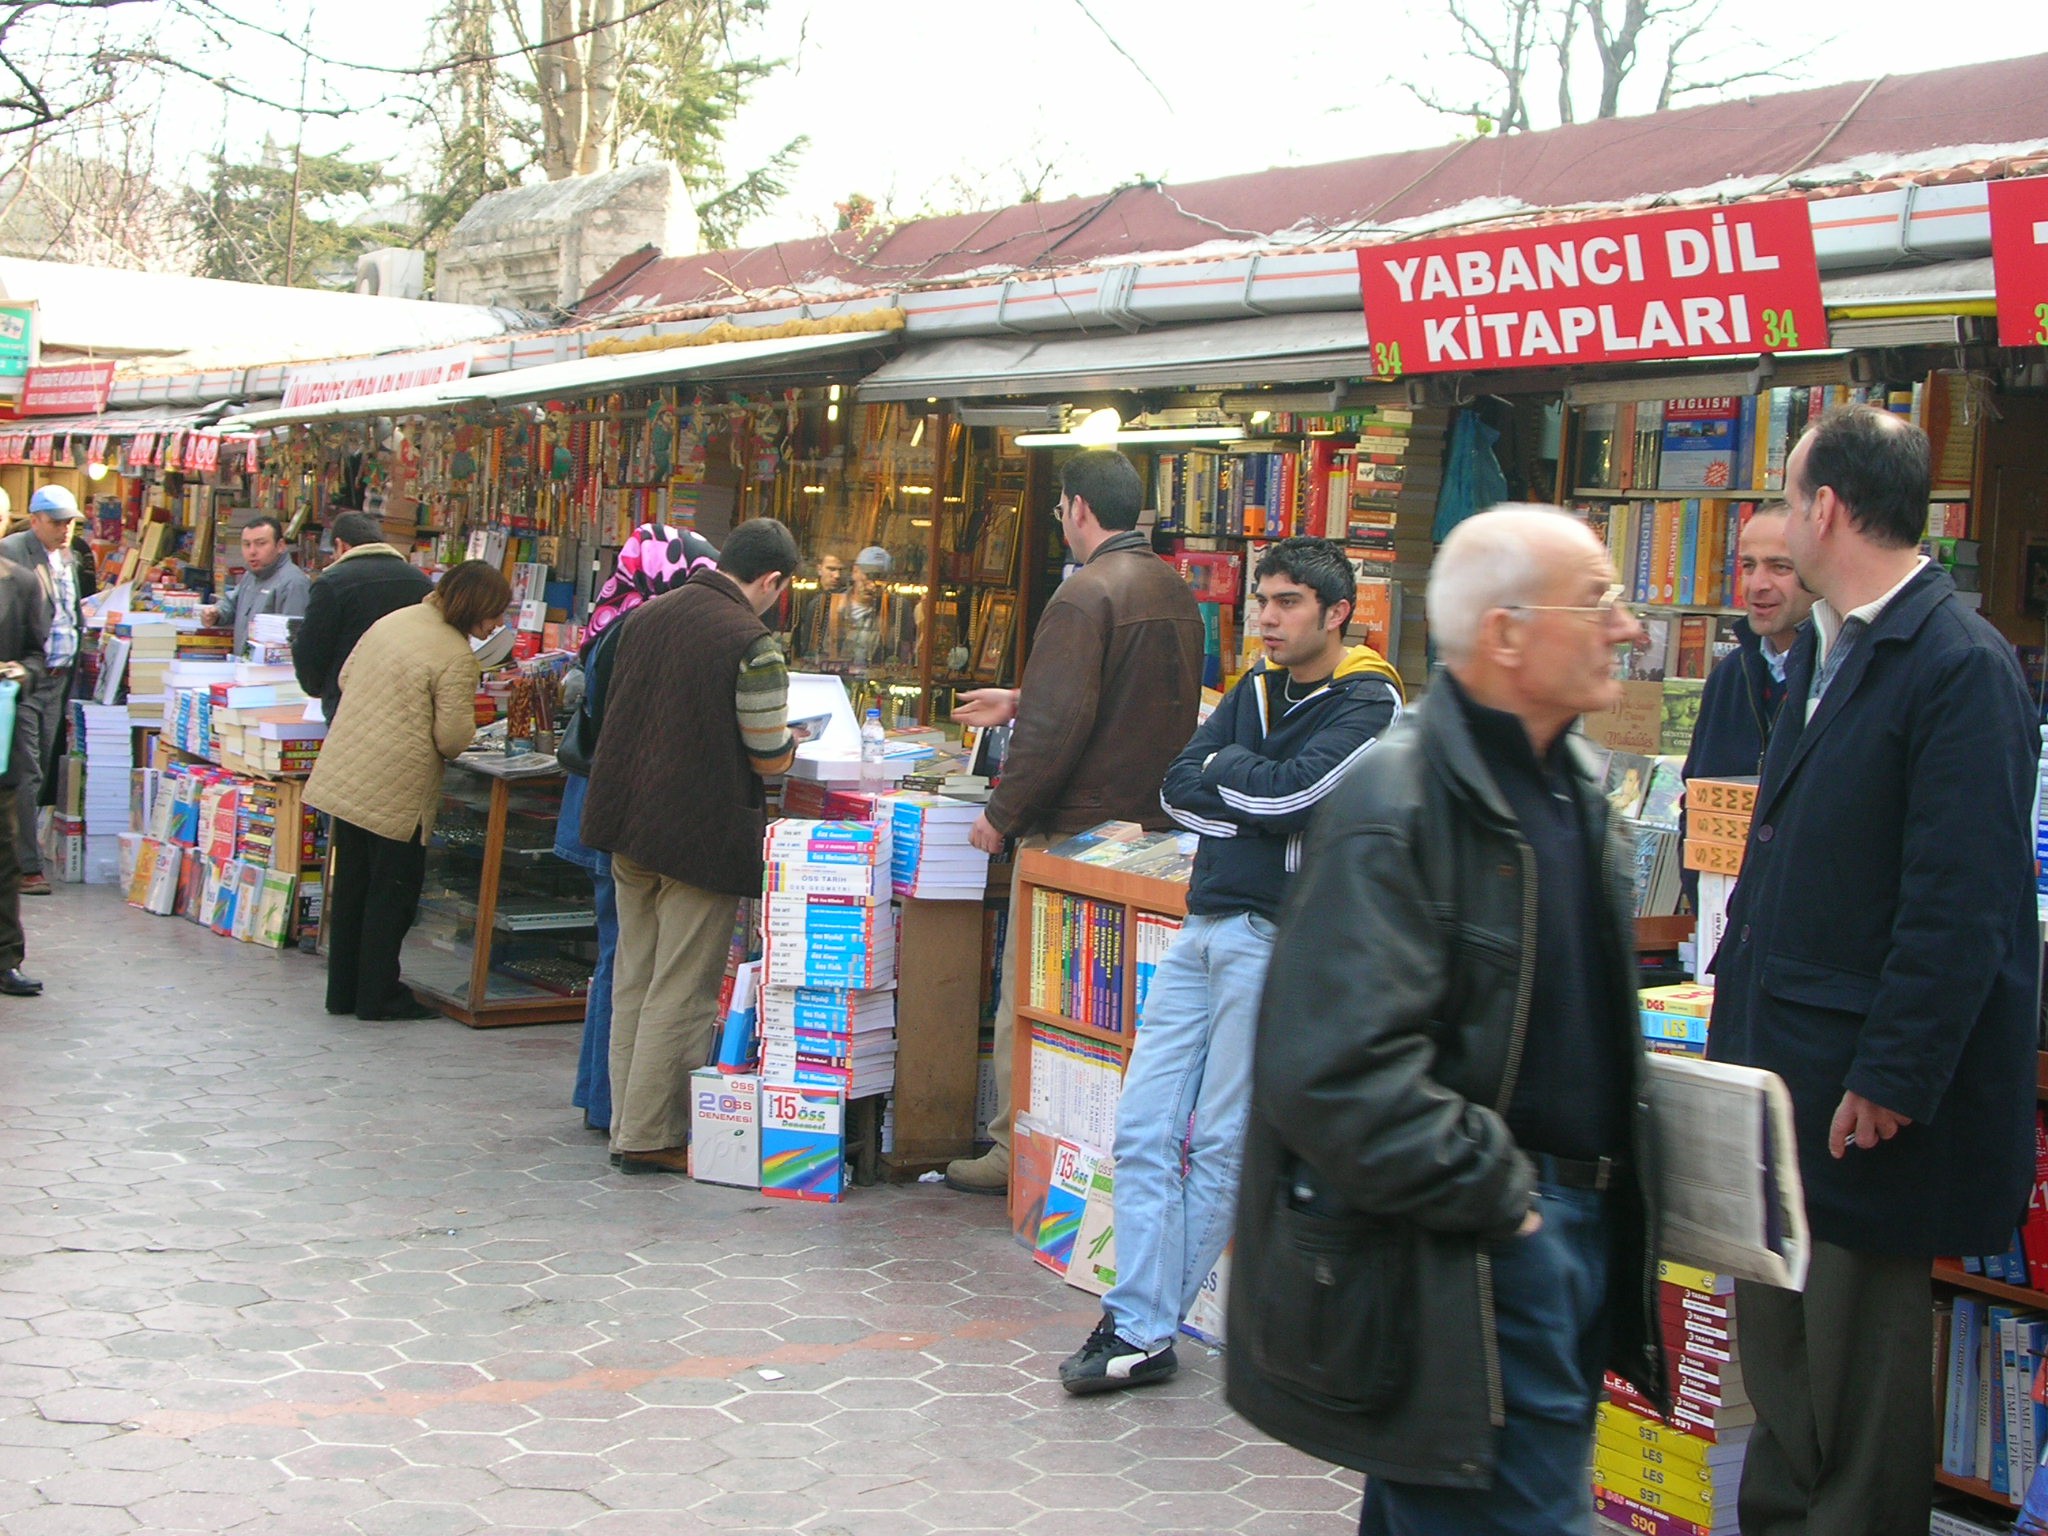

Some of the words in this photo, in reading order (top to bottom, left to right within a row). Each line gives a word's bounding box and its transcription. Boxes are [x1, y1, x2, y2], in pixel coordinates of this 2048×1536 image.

[1383, 234, 1644, 302] YABANCI
[1664, 212, 1780, 278] DİL
[1423, 294, 1752, 363] KİTAPLARI
[1762, 309, 1798, 347] 34
[1375, 341, 1402, 375] 34
[1668, 397, 1731, 410] ENGLISH
[1639, 512, 1651, 586] REDHOUSE
[1668, 516, 1679, 578] REDHOUSE
[1646, 999, 1665, 1011] DGS
[1663, 1018, 1688, 1038] LES
[698, 1092, 737, 1113] 20
[774, 1095, 797, 1120] 15
[1060, 1152, 1074, 1180] 15
[1604, 1374, 1638, 1394] L.E.S.
[2006, 1384, 2016, 1425] TEMEL
[2020, 1391, 2032, 1431] TEMEL
[1639, 1426, 1659, 1442] LES
[1642, 1447, 1663, 1464] LES
[2009, 1434, 2021, 1468] FİZİK
[2023, 1439, 2034, 1473] FİZİK
[1642, 1467, 1664, 1484] LES
[1640, 1488, 1661, 1505] LES
[1631, 1513, 1657, 1535] DGS
